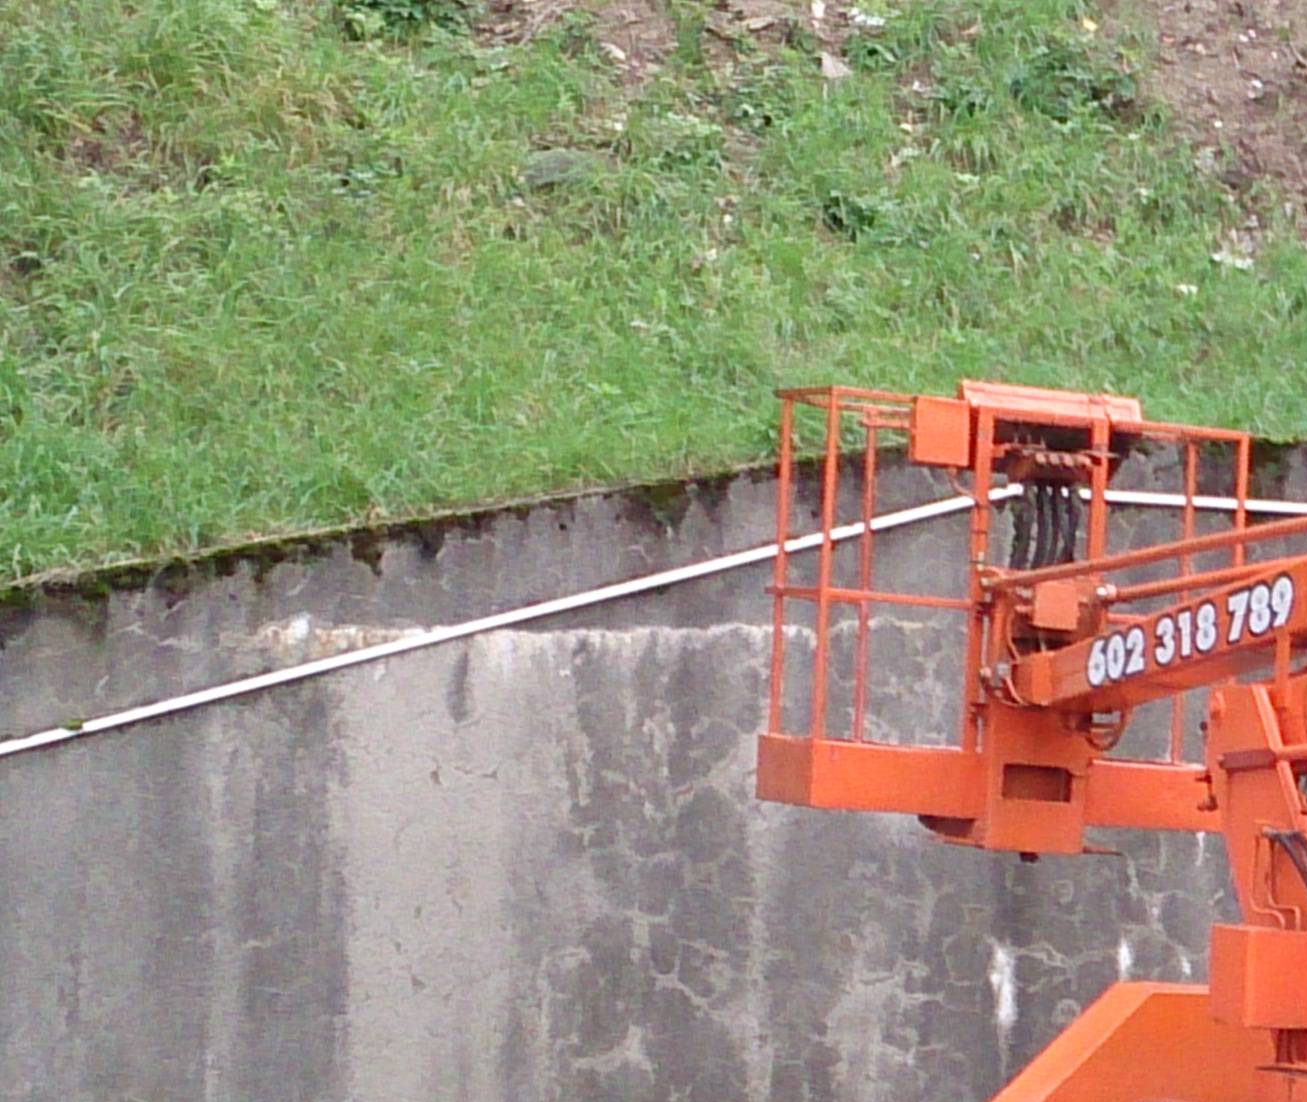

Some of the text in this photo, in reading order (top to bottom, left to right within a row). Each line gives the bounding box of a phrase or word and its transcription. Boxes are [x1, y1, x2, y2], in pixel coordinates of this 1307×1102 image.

[1087, 572, 1295, 688] 602 318 789
